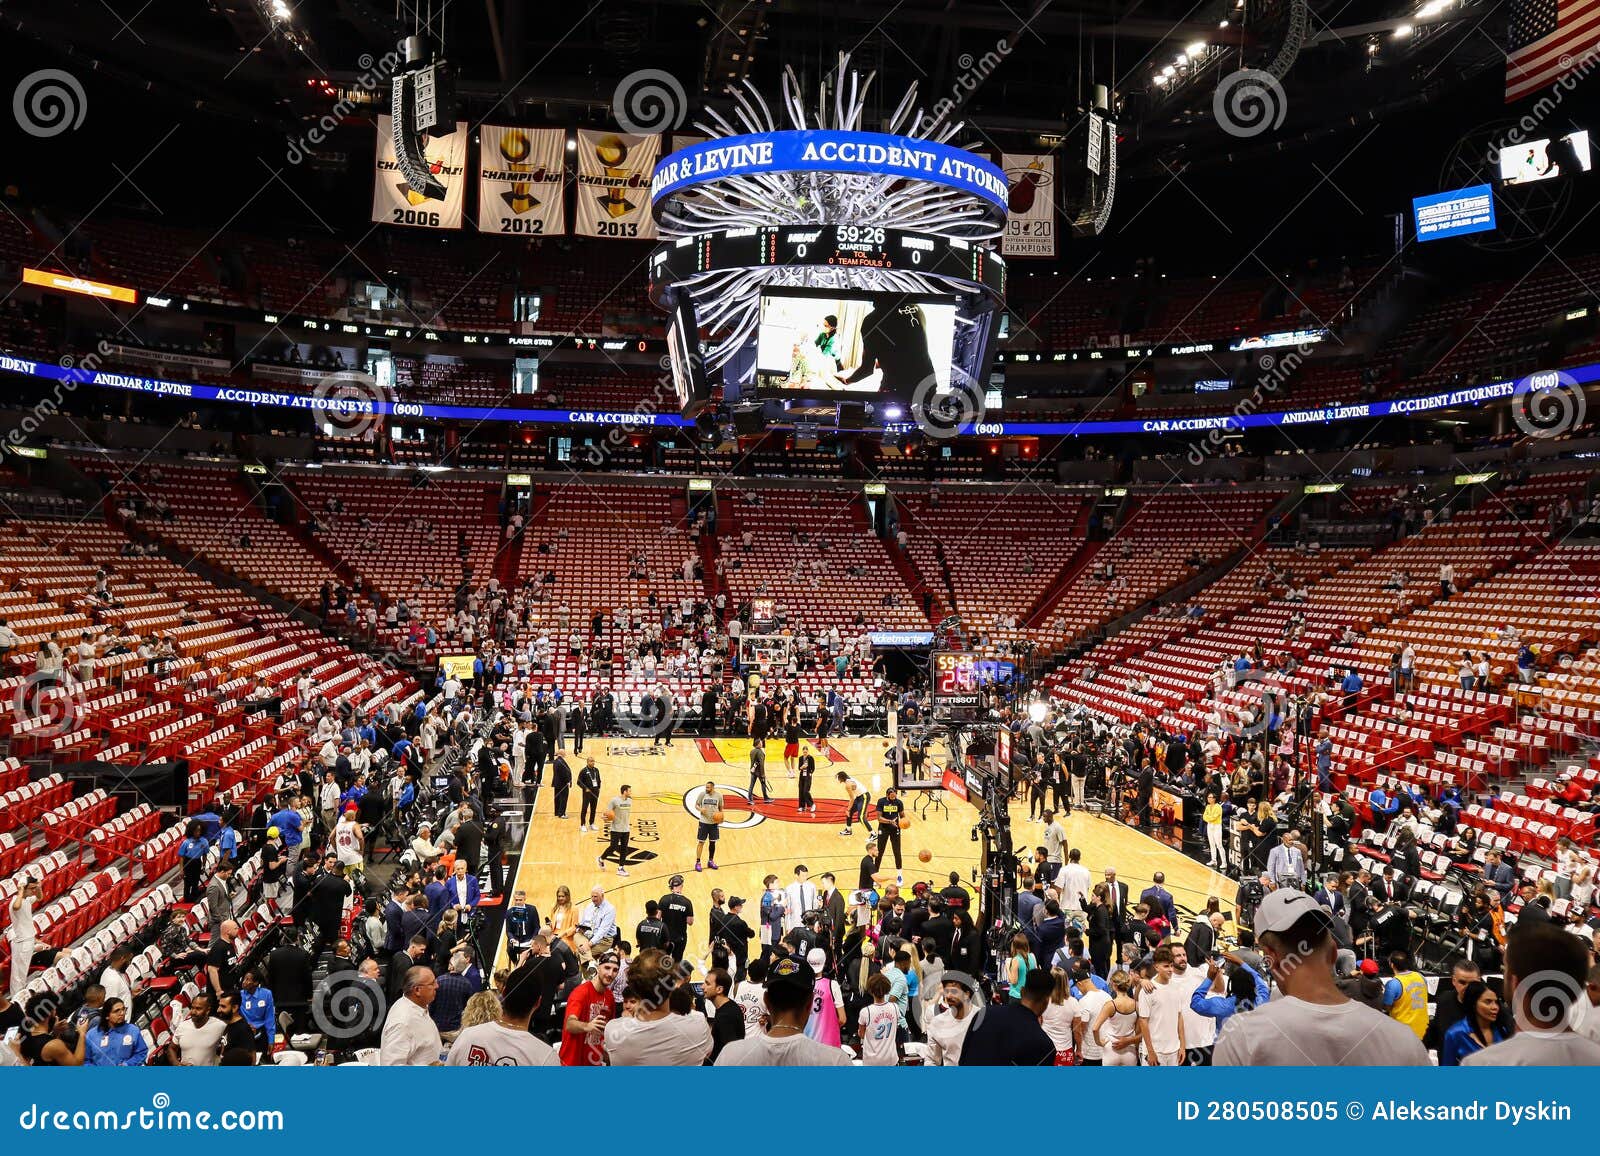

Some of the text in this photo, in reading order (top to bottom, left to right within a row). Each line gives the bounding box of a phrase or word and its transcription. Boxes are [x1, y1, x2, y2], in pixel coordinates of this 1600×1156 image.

[652, 142, 773, 196] IDJAR & LEVINE
[802, 141, 1008, 207] ACCIDENT ATTORNE
[393, 208, 440, 227] 2006
[500, 218, 543, 234] 2012
[597, 221, 638, 237] 2013
[1006, 221, 1051, 236] 19 20
[837, 226, 885, 244] 59:26
[797, 244, 807, 257] 0
[838, 243, 873, 252] QUARTER
[1005, 244, 1052, 252] CHAMPIONS
[859, 259, 883, 267] FOULS
[886, 260, 892, 268] 0
[912, 250, 921, 264] 0
[304, 320, 317, 329] PTS
[324, 323, 330, 331] 0
[343, 325, 358, 333] REB
[385, 328, 398, 337] AST
[425, 332, 438, 341] STL
[509, 338, 533, 346] PLAYER
[638, 341, 647, 351] 0
[1054, 353, 1066, 361] AST
[1172, 346, 1195, 355] PLAYER
[0, 356, 36, 374] IDENT
[93, 373, 192, 396] ANIDJAR & LEVINE
[1530, 373, 1559, 390] (800)
[216, 388, 373, 413] ACCIDENT ATTORNEYS
[1389, 382, 1514, 414] ACCIDENT ATTORNEYS
[393, 404, 423, 416] (800)
[1282, 405, 1370, 424] ANIDJAR & LEVINE
[569, 412, 656, 425] CAR ACCIDENT
[1143, 417, 1230, 432] CAR ACCIDENT
[975, 423, 1004, 434] (800)
[872, 635, 927, 645] ticketmaster
[452, 662, 471, 674] Finals
[939, 656, 974, 670] 59:26
[630, 819, 660, 842] Center
[669, 903, 686, 912] ESPN
[640, 925, 660, 935] ESPN
[740, 993, 759, 1004] BUTLER
[814, 997, 823, 1013] 3
[875, 1022, 892, 1040] 21
